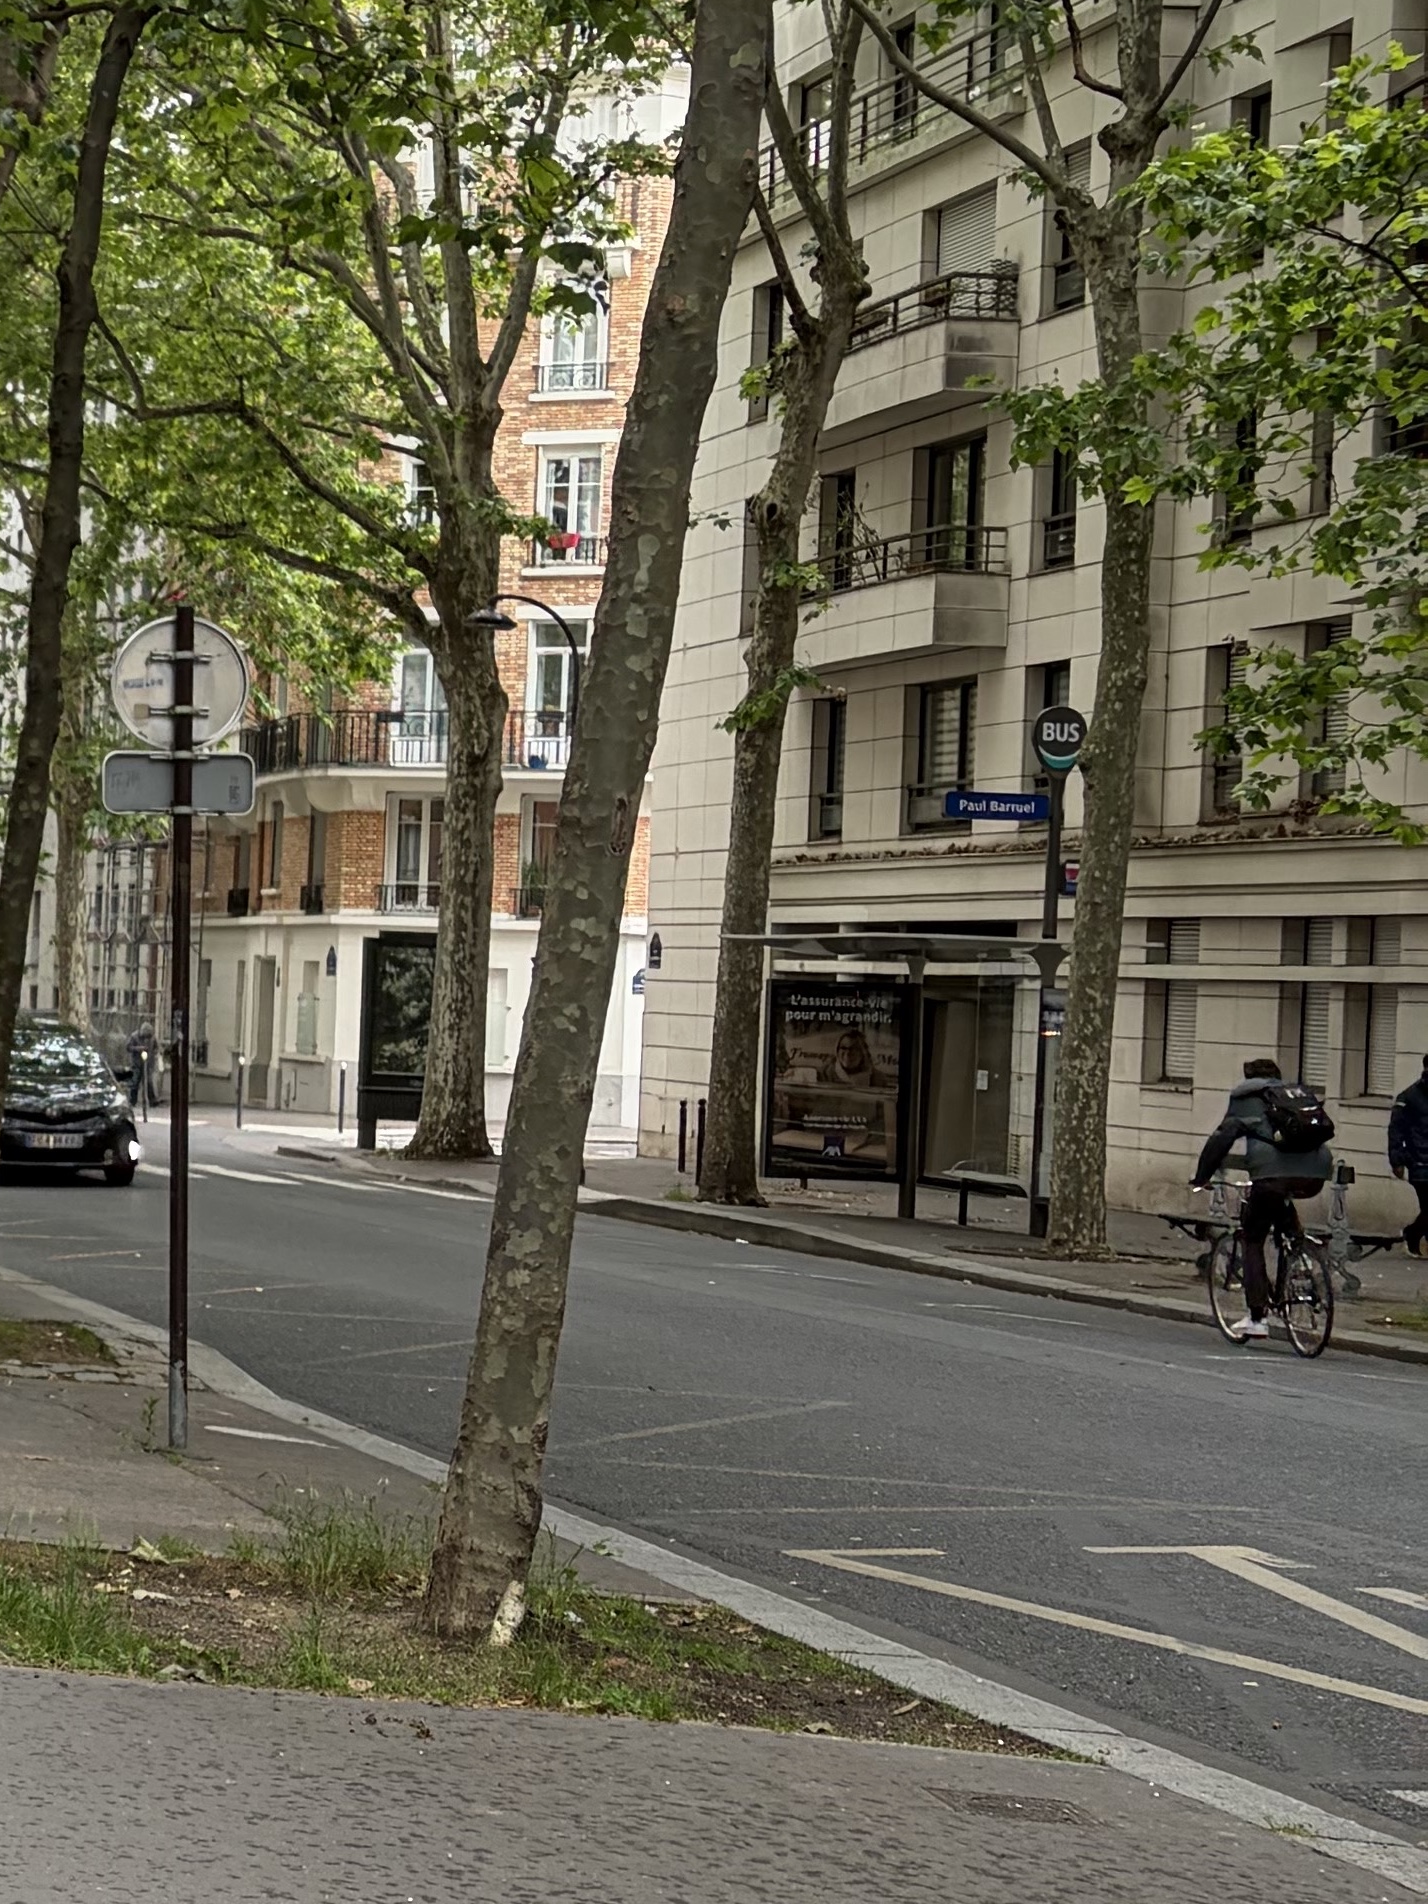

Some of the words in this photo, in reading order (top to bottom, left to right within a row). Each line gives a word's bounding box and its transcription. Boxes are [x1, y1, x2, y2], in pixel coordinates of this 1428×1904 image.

[1042, 721, 1081, 743] BUS
[959, 799, 987, 812] Paul
[989, 800, 1036, 814] Barruel
[784, 1010, 815, 1023] pour
[818, 1009, 893, 1025] m'agrandir.
